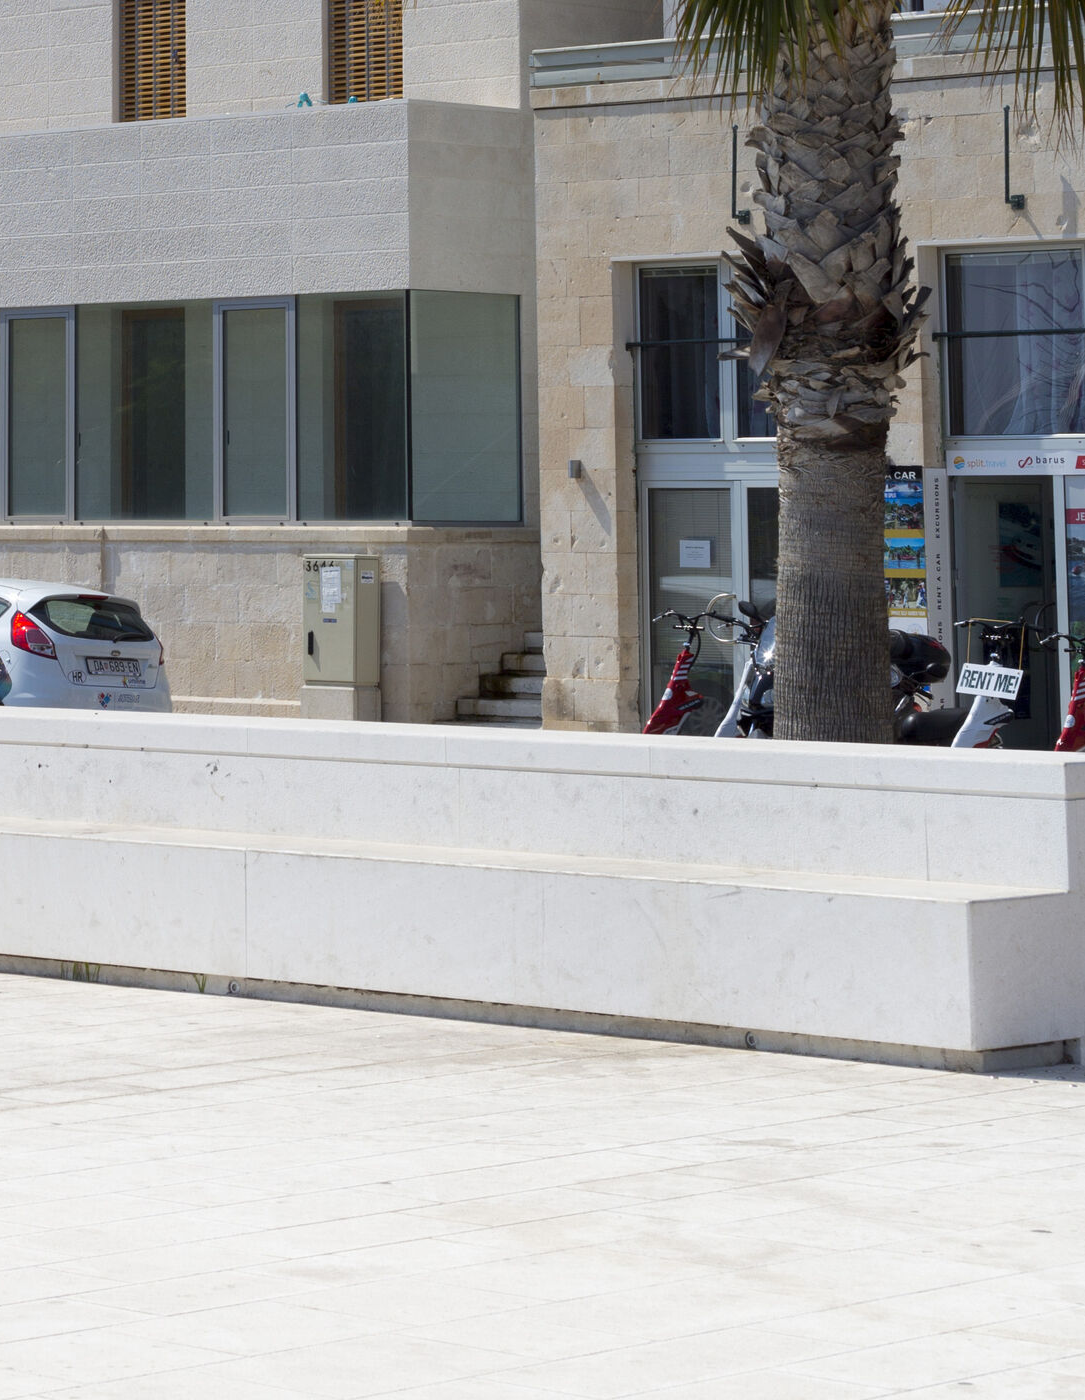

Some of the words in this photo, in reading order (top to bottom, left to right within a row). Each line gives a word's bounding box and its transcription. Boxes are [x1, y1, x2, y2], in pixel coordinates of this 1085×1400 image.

[1035, 456, 1066, 464] barus
[894, 471, 916, 480] CAR
[109, 661, 139, 673] 689-EN
[72, 672, 83, 683] HR
[960, 669, 995, 690] RENT
[993, 673, 1020, 694] ME!
